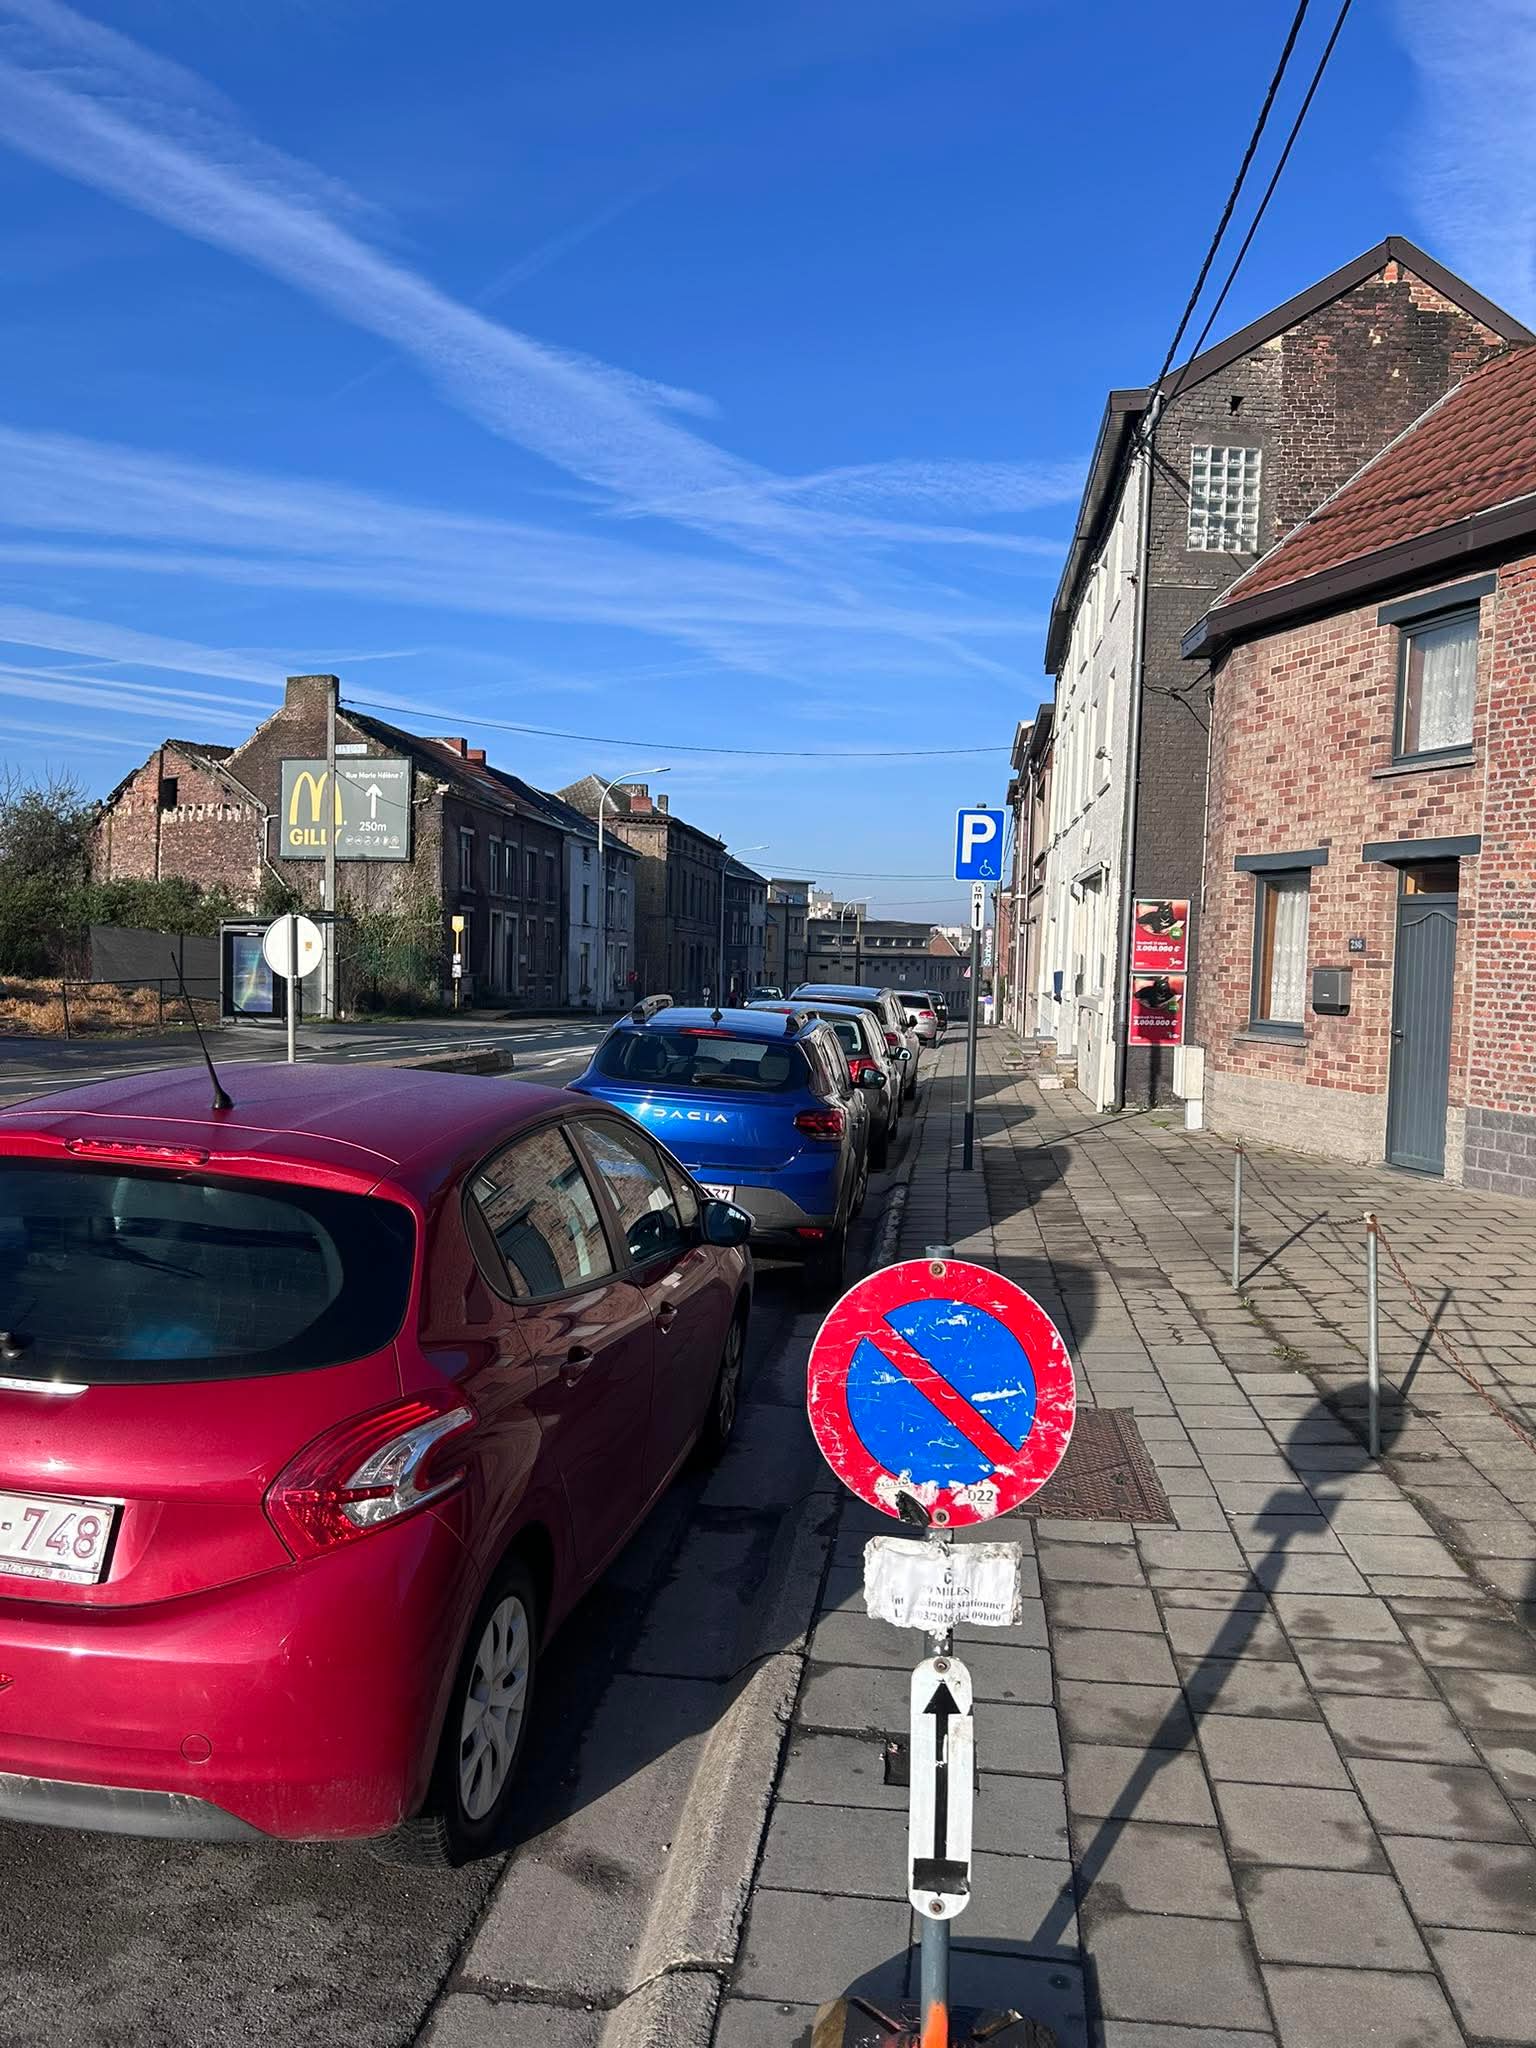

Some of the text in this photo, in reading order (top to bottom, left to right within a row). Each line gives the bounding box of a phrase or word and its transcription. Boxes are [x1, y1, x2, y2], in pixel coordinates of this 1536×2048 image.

[359, 821, 387, 831] 250m
[962, 814, 997, 863] P
[974, 885, 982, 893] 12
[653, 1108, 728, 1123] DACIA
[957, 1597, 1006, 1610] stationner
